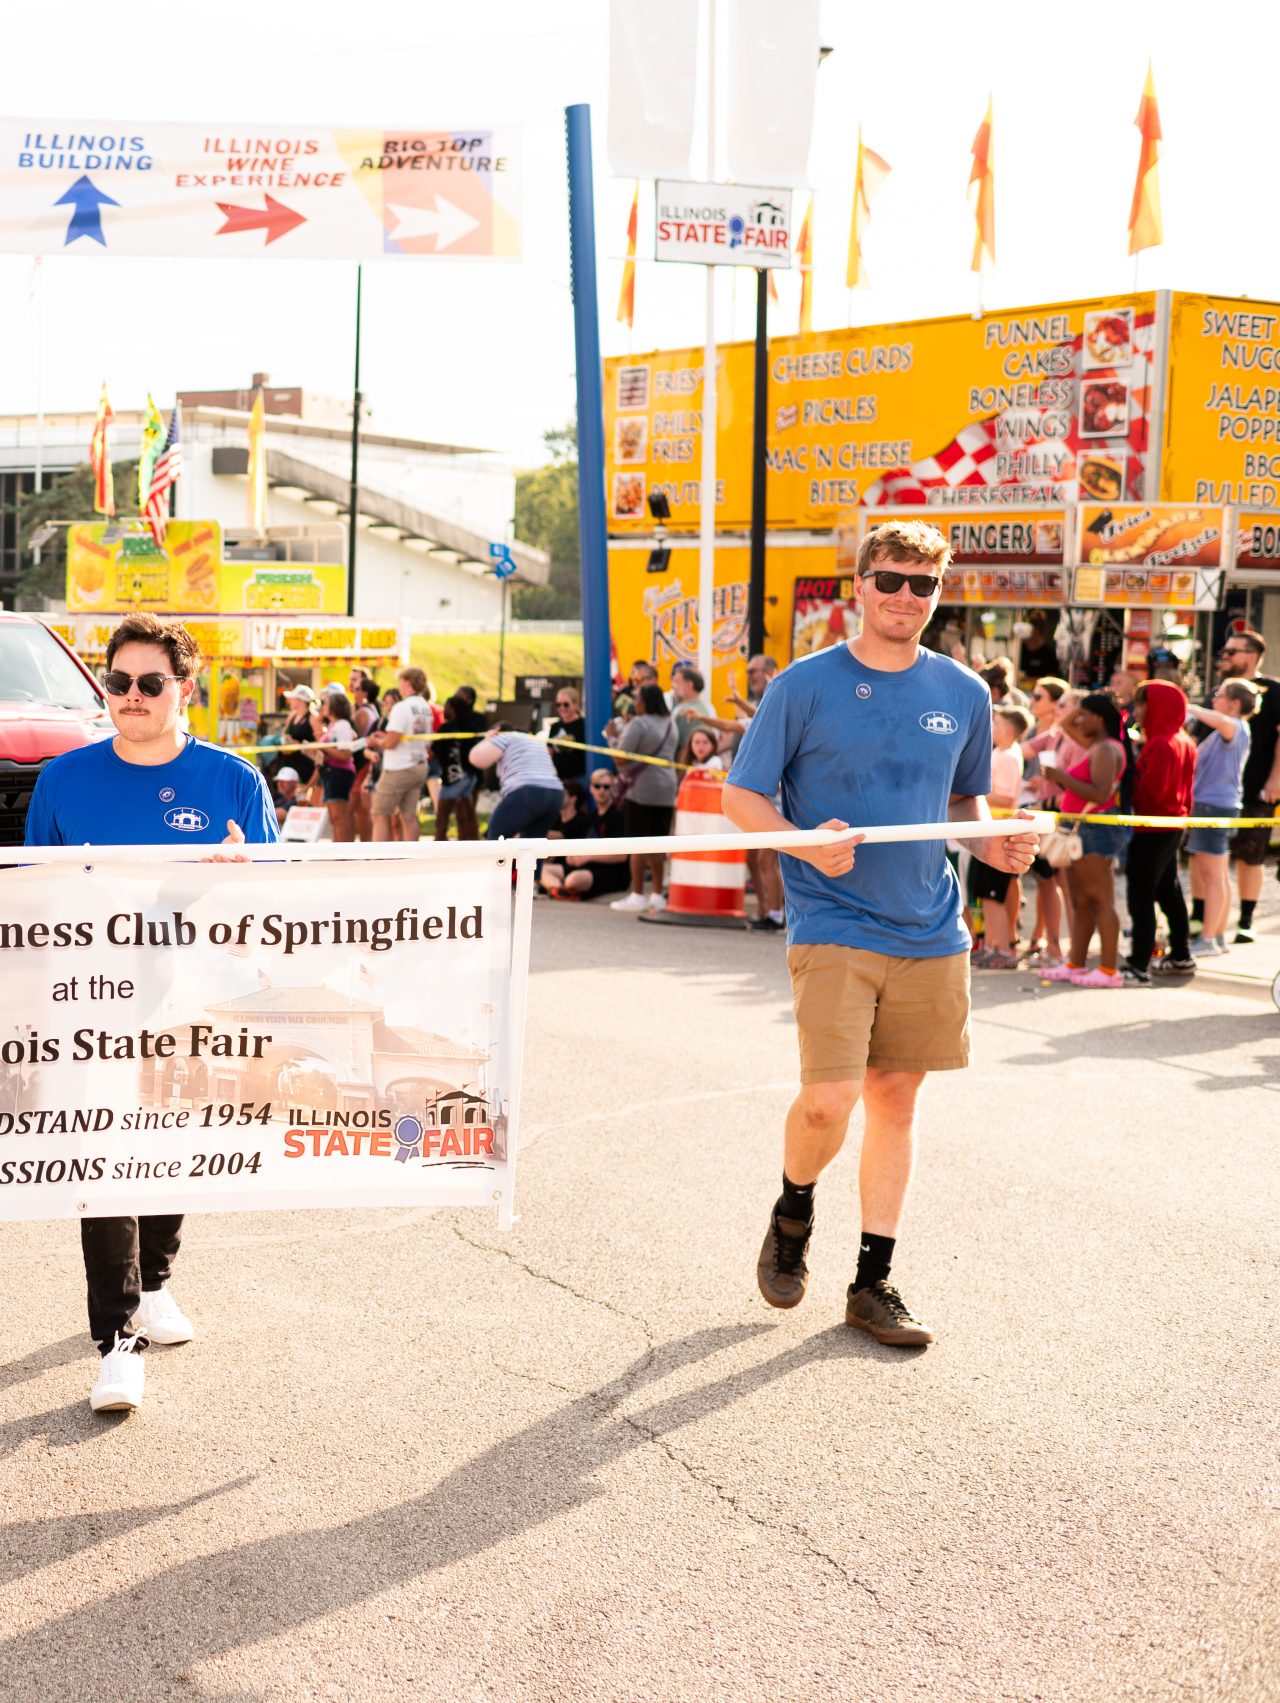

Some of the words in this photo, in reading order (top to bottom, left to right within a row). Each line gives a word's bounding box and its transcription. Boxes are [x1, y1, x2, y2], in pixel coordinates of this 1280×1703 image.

[24, 134, 145, 153] ILLINOIS
[203, 138, 319, 156] ILLINOIS
[383, 139, 427, 155] BIG
[439, 138, 484, 153] TOP
[17, 153, 153, 172] BUILDING
[226, 157, 295, 173] WINE
[360, 156, 508, 173] ADVENTURE
[175, 172, 347, 188] EXPERIENCE
[660, 206, 726, 221] ILLINOIS
[659, 221, 726, 244] STATE
[745, 227, 788, 248] FAIR
[985, 316, 1075, 346] FUNNEL
[1202, 310, 1276, 339] SWEET
[773, 352, 842, 383] CHEESE
[846, 343, 913, 375] CURDS
[1004, 346, 1073, 376] CAKES
[655, 369, 697, 396] FRIES
[969, 380, 1072, 412] BONELESS
[802, 395, 878, 426] PICKLES
[996, 415, 1070, 440] WINGS
[652, 440, 694, 463] FRIES
[766, 446, 808, 472] MAC
[838, 440, 912, 470] CHEESE
[996, 451, 1067, 477] PHILLY
[810, 479, 858, 505] BITES
[1195, 481, 1276, 507] PULLED
[950, 523, 1033, 553] FINGERS
[1101, 509, 1151, 543] Fries
[1144, 527, 1218, 566] Pretzels
[797, 579, 836, 597] HOT
[106, 911, 198, 948] Club
[208, 914, 255, 946] of
[260, 904, 485, 954] Springfield
[52, 976, 79, 1001] at
[89, 974, 135, 1000] the
[72, 1028, 177, 1061] State
[189, 1025, 273, 1059] Fair
[120, 1104, 190, 1131] since
[200, 1102, 274, 1128] 1954
[288, 1108, 392, 1128] ILLINOIS
[283, 1129, 391, 1158] STATE
[422, 1128, 494, 1157] FAIR
[111, 1154, 181, 1180] since
[188, 1151, 263, 1178] 2004
